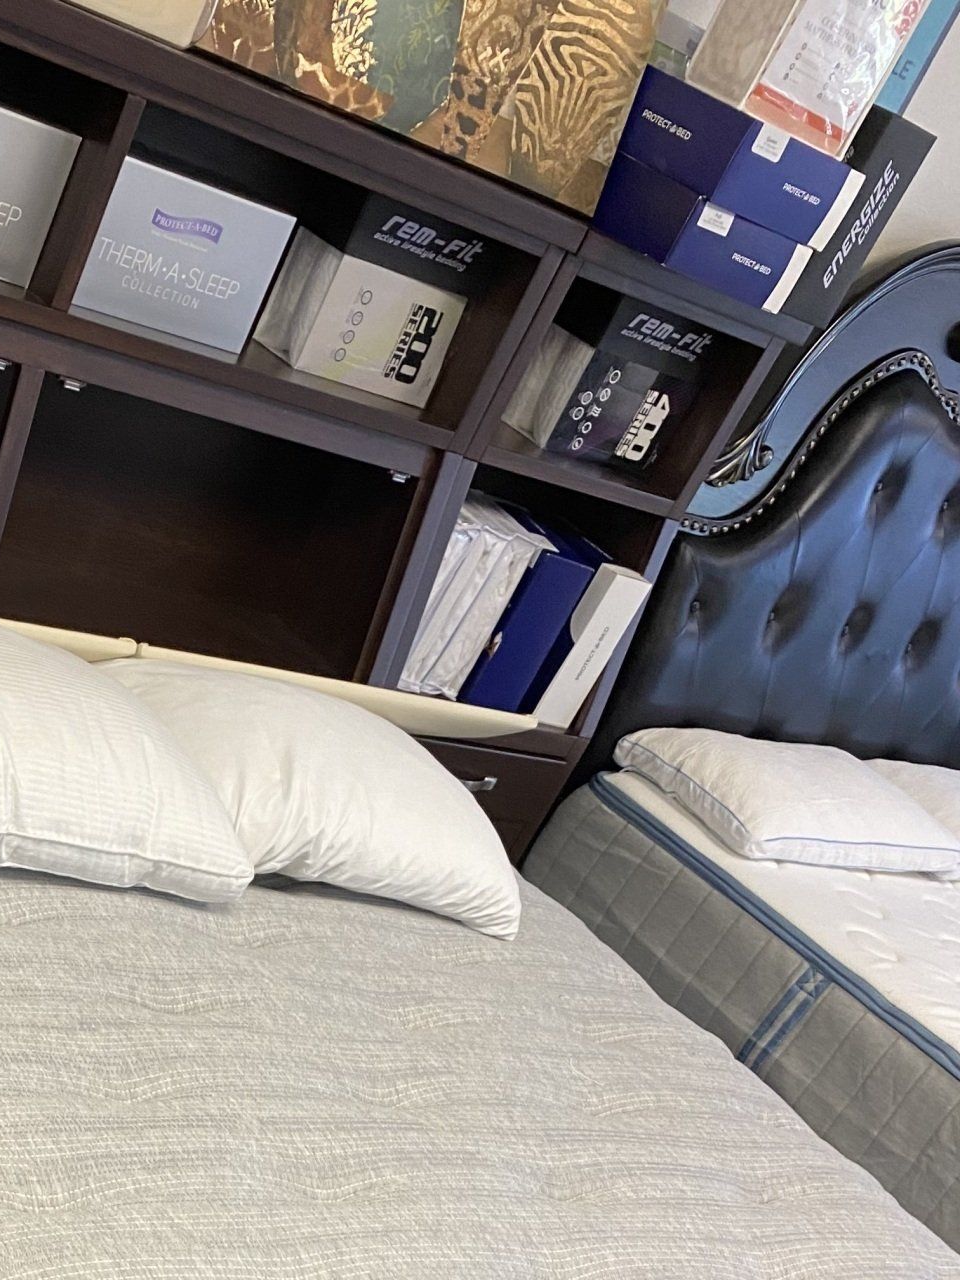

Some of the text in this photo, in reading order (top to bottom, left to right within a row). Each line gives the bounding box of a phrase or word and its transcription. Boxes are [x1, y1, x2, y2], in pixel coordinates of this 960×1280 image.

[858, 172, 900, 245] Collection
[122, 275, 200, 309] COLLECTION
[384, 304, 424, 379] SERIES
[394, 307, 444, 384] 200
[615, 389, 659, 458] SERIES
[625, 394, 670, 462] 400
